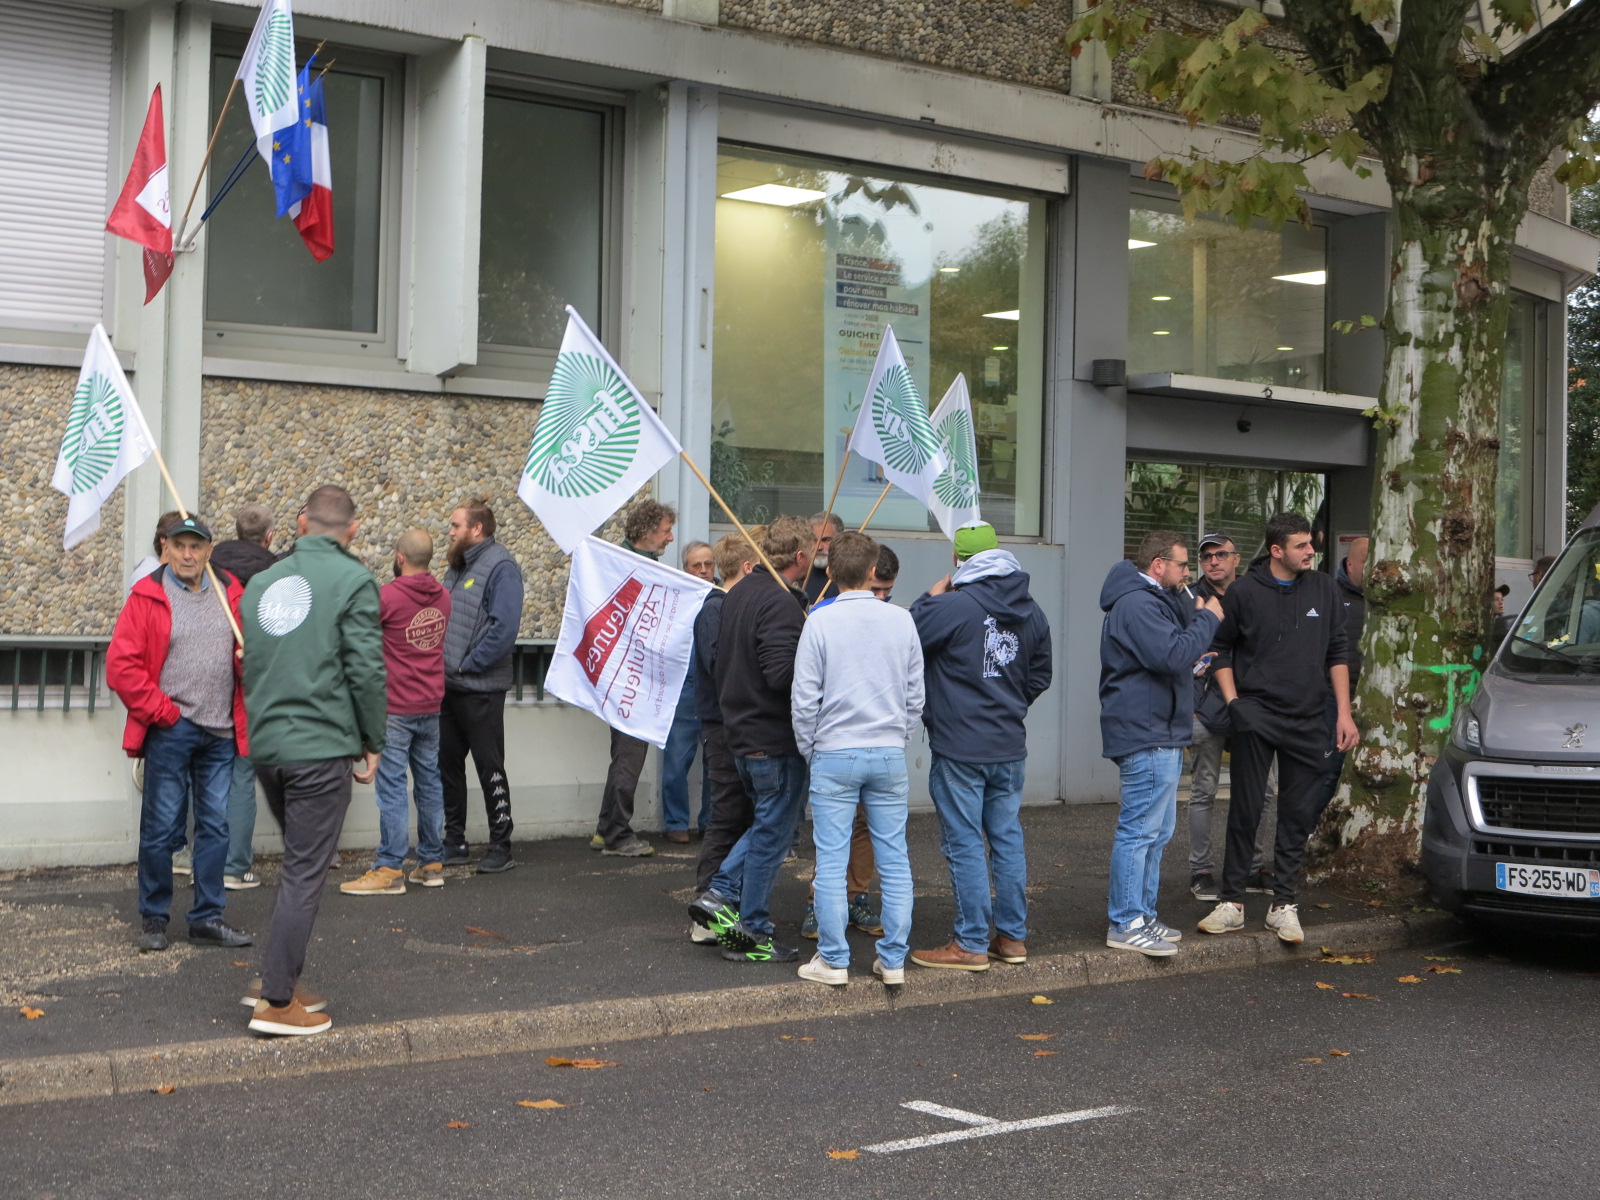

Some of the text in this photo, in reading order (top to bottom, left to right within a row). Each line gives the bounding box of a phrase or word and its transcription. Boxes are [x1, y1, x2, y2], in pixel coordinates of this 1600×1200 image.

[843, 271, 900, 284] Le service publi
[843, 286, 884, 296] pour mieux
[843, 300, 871, 309] rénover
[889, 304, 915, 314] habitat
[839, 329, 880, 340] GUICHET
[412, 627, 432, 637] 100%
[1508, 867, 1587, 892] FS-255-WD
